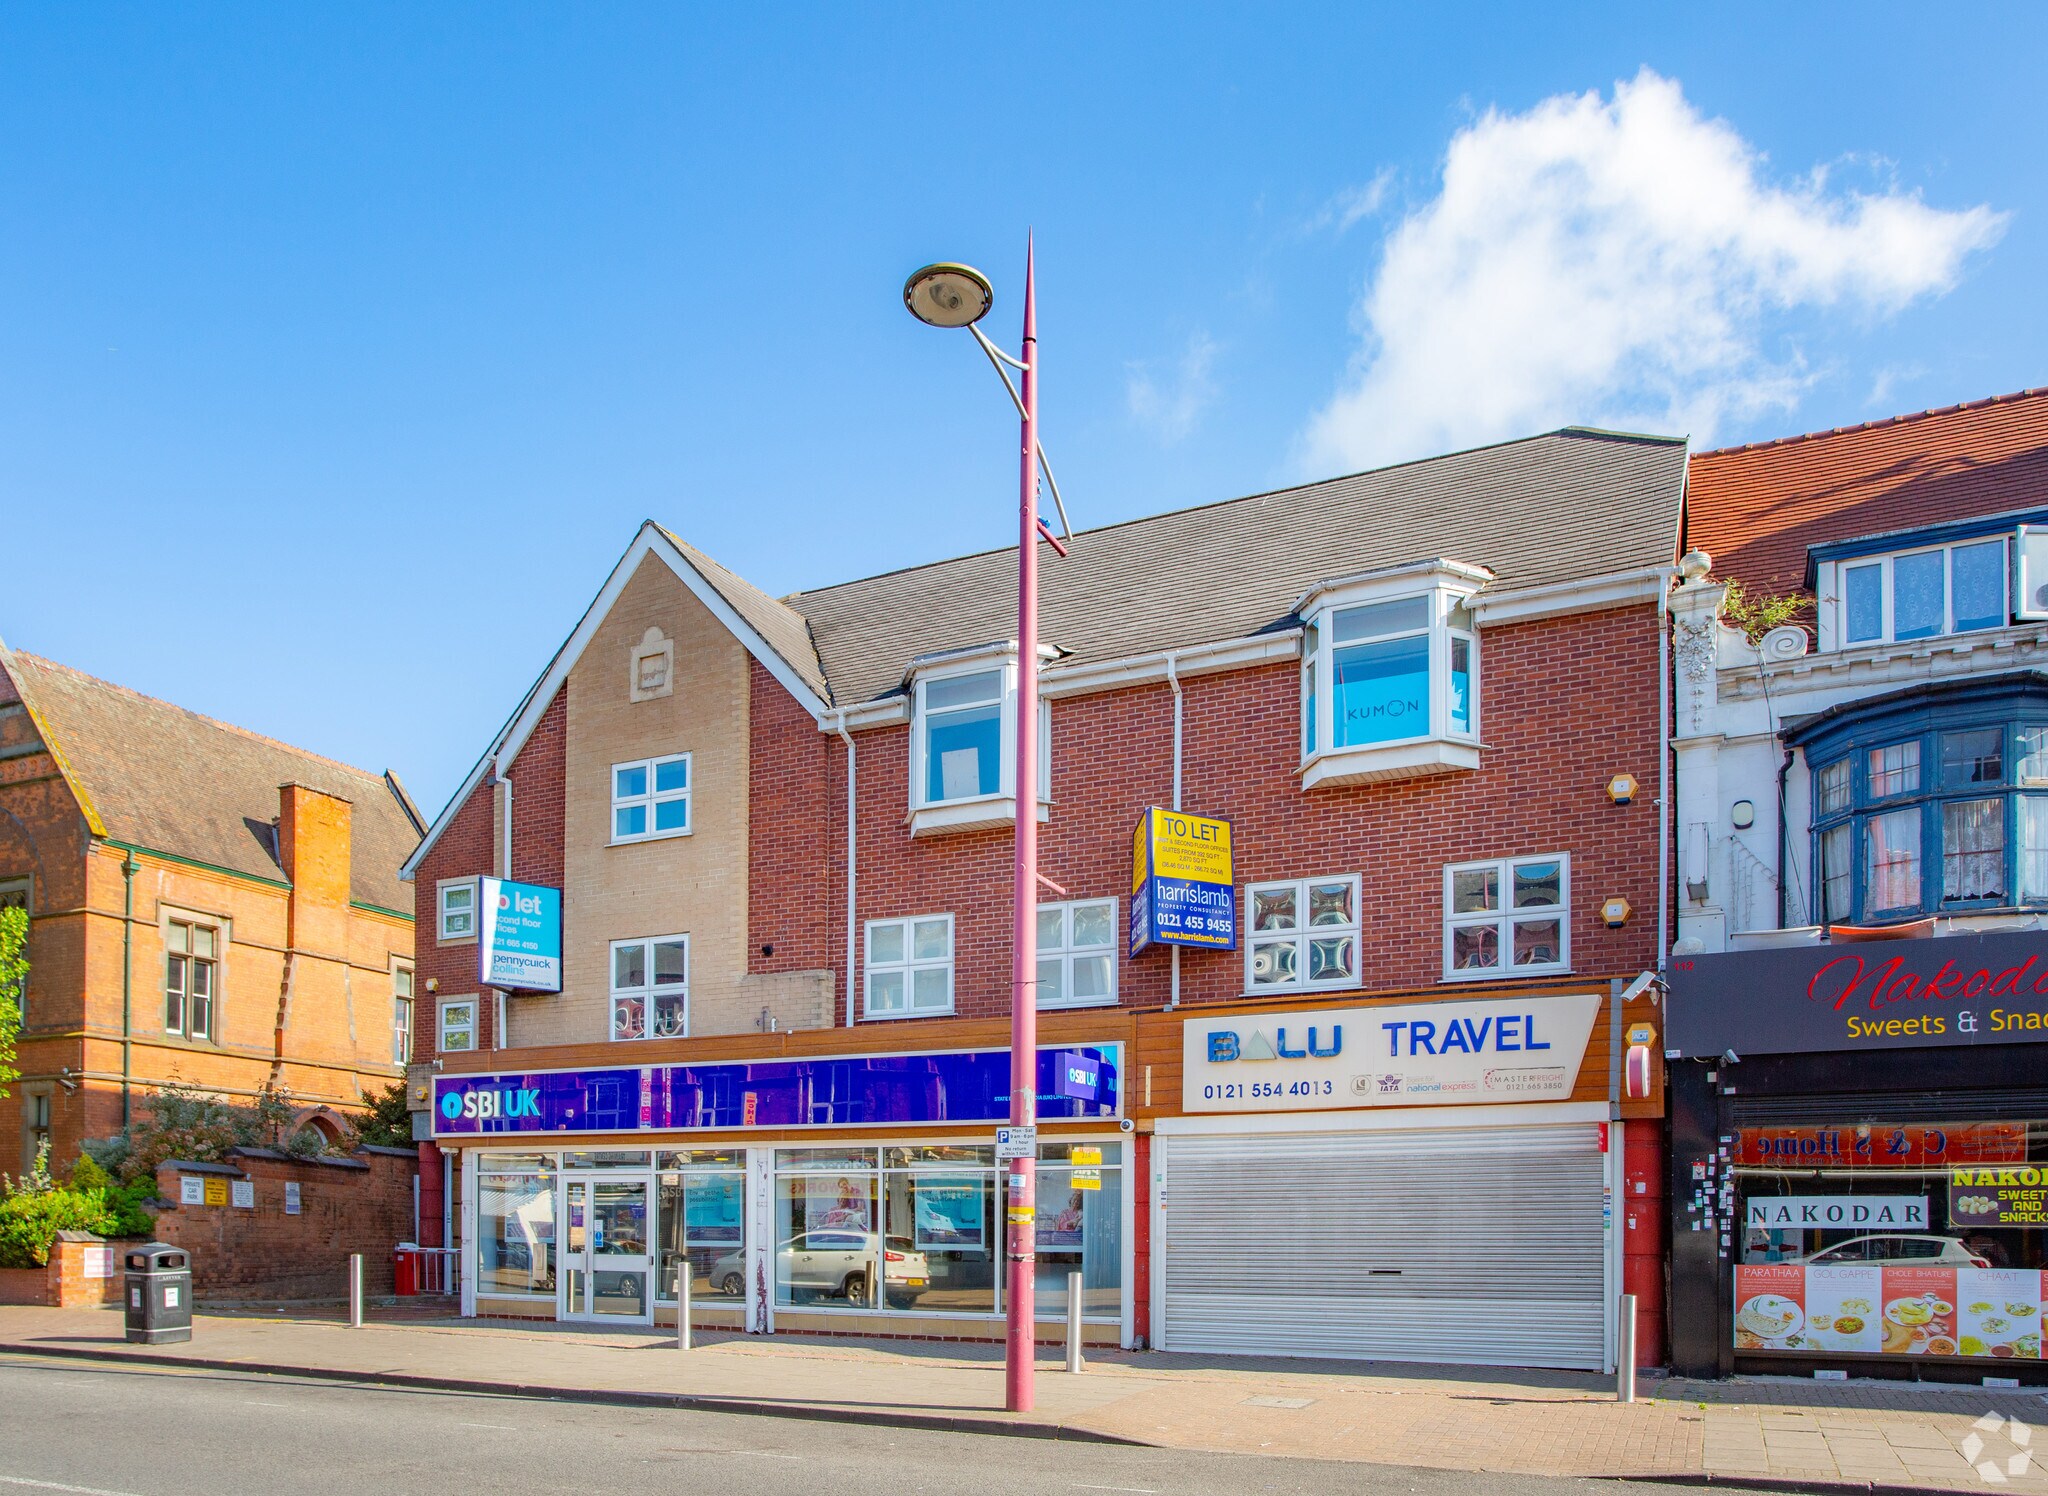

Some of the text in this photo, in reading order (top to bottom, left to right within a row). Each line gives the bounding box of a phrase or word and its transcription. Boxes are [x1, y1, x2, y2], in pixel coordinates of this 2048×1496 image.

[1348, 700, 1419, 720] KUMON
[1164, 817, 1219, 842] TO LET
[1162, 846, 1180, 854] SUITES
[1174, 839, 1193, 847] SECOND
[1210, 845, 1228, 853] OFFICES
[1157, 880, 1230, 907] harrislamb
[515, 891, 542, 915] let
[1158, 903, 1230, 915] PROPERTY CONSULTANCY
[497, 916, 541, 928] cond floor
[1157, 912, 1231, 932] 0121 455 9455
[497, 924, 517, 934] fices
[1161, 931, 1229, 944] www.harrislamb.com
[522, 941, 538, 950] 4150
[493, 954, 551, 969] pennycuick
[1674, 961, 1695, 971] 112
[493, 964, 525, 976] collins
[1847, 1014, 1946, 1038] Sweets
[1957, 1010, 1979, 1033] &
[1382, 1015, 1551, 1057] TRAVEL
[1633, 1031, 1649, 1040] ADT
[1075, 1069, 1097, 1087] SBI UK
[1204, 1084, 1243, 1099] 0121
[1251, 1082, 1283, 1098] 554
[1289, 1081, 1332, 1096] 4013
[1407, 1082, 1477, 1093] national express
[463, 1089, 541, 1119] SBI UK
[1998, 1190, 2048, 1201] SWEET
[2012, 1201, 2042, 1211] AND
[1751, 1205, 1922, 1223] NAKODAR
[1744, 1267, 1800, 1278] PARATHAA
[1813, 1269, 1874, 1280] GOL GAPPE
[1887, 1270, 1952, 1278] CHOLE BHATURE
[1978, 1271, 2019, 1282] CHAAT
